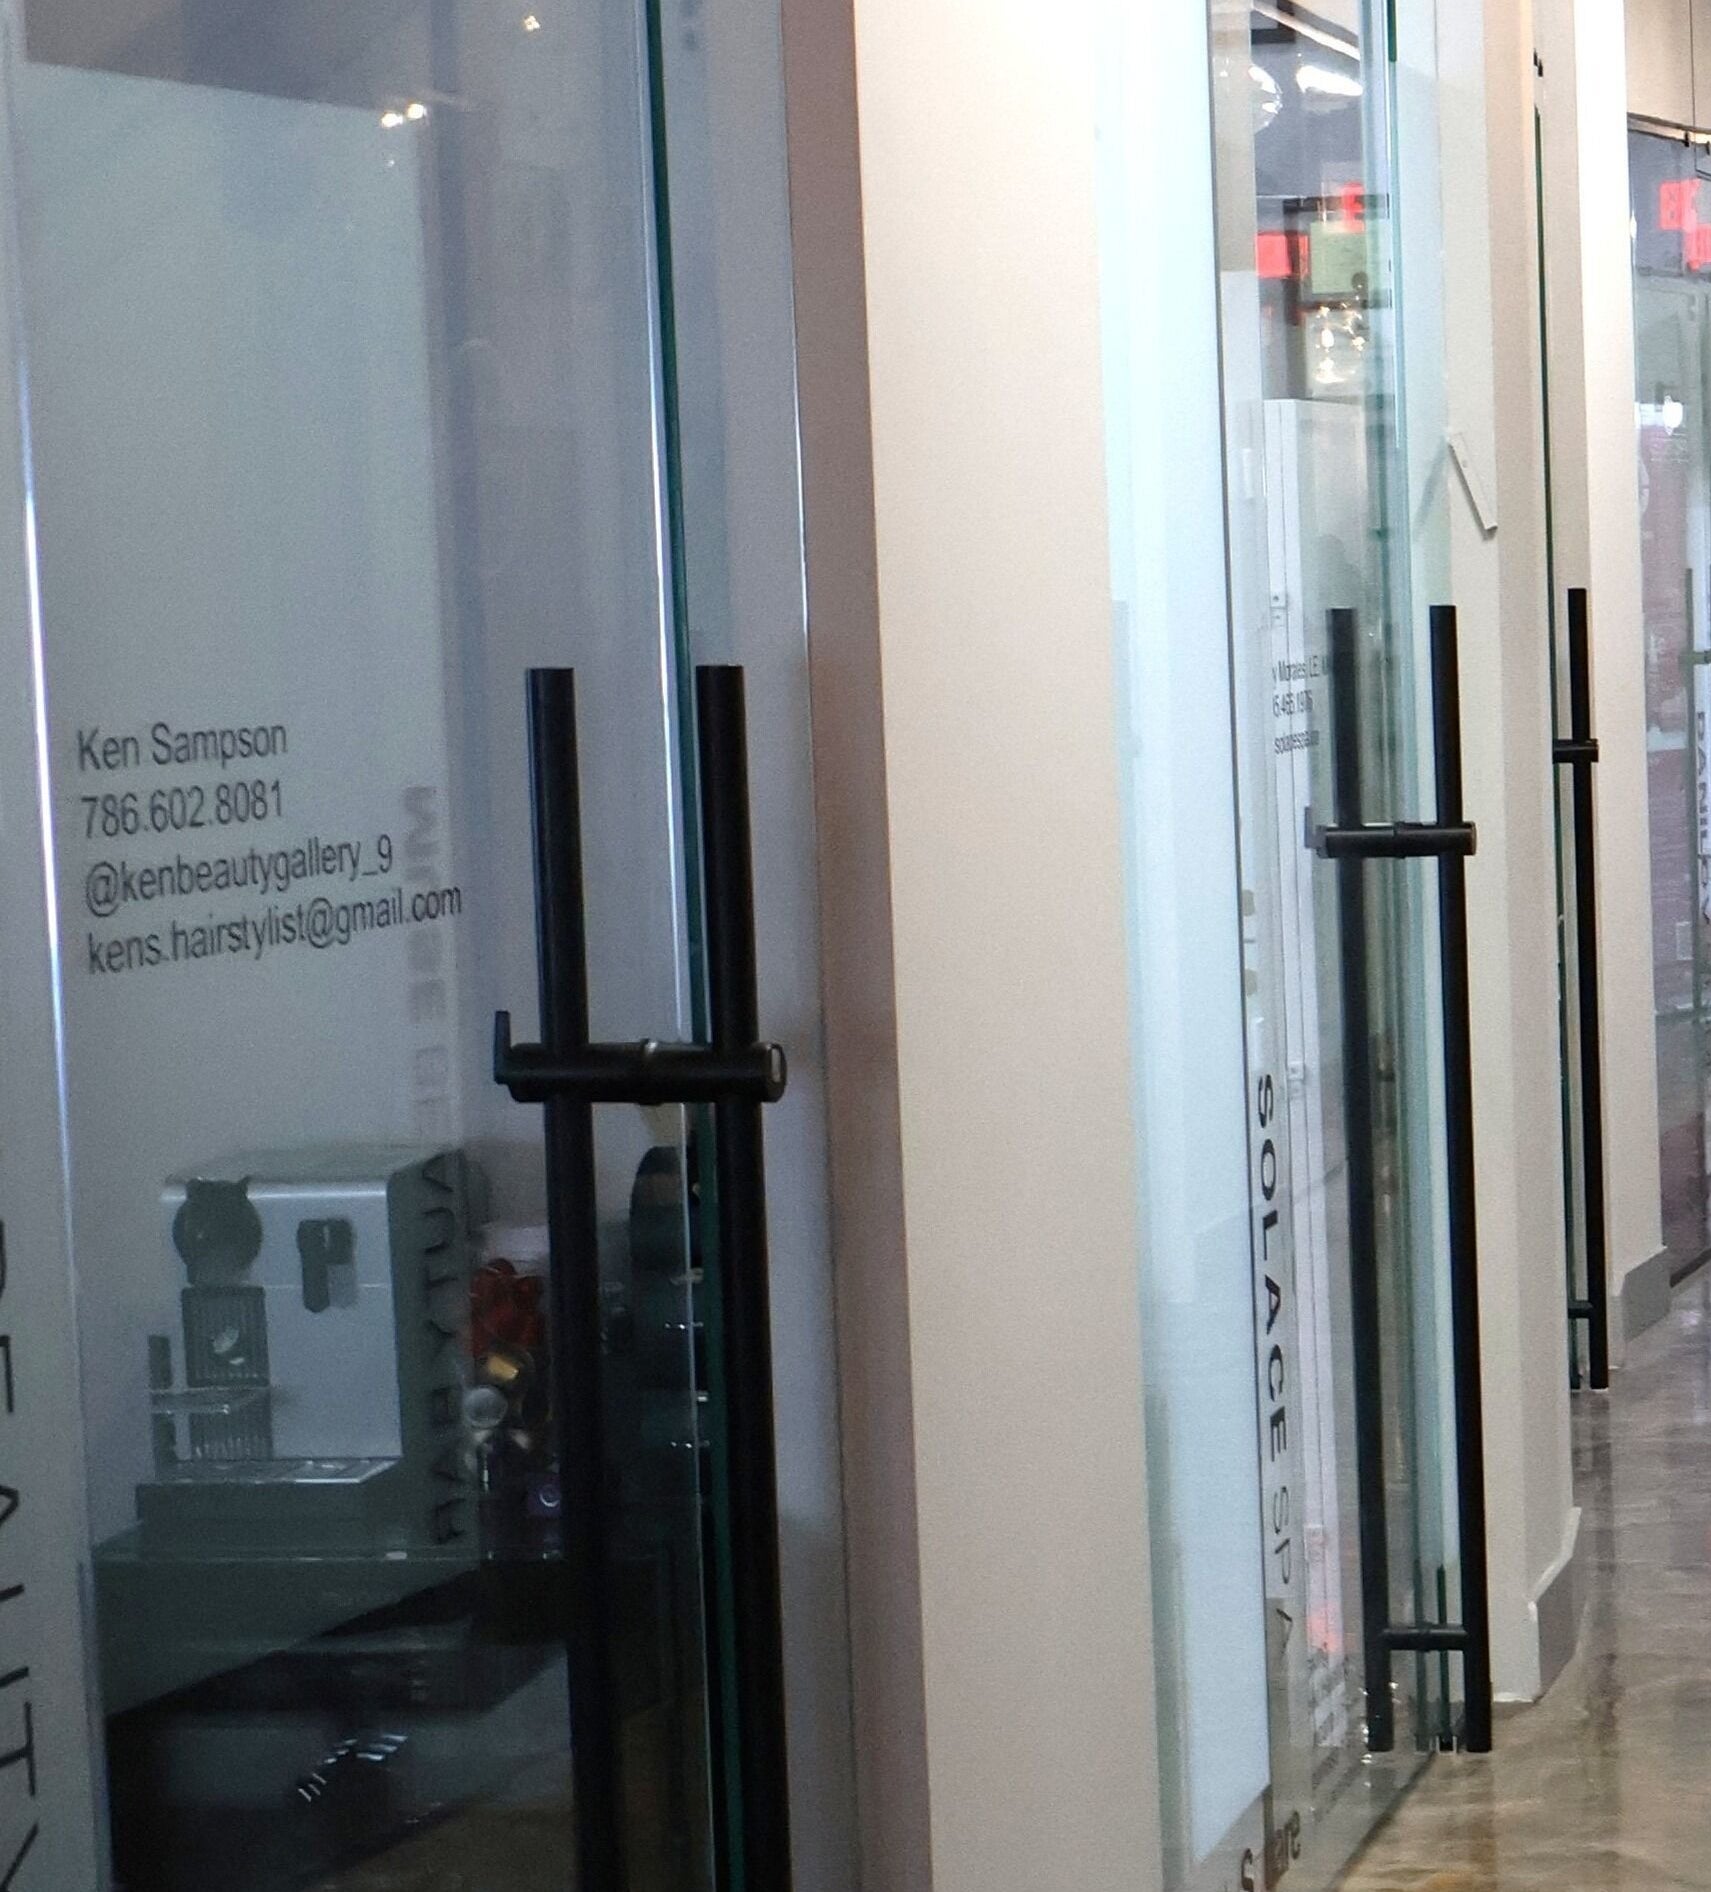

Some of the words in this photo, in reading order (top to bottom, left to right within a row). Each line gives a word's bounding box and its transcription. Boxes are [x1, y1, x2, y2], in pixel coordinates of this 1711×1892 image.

[78, 728, 140, 772] Ken
[151, 722, 287, 769] Sampson
[82, 780, 283, 838] 786.602.8081
[85, 834, 393, 917] @kenbeautygallery_9
[89, 885, 462, 975] kens.hairstylist@gmail.com
[1257, 1073, 1287, 1463] SOLACE
[1272, 1483, 1293, 1658] SPA
